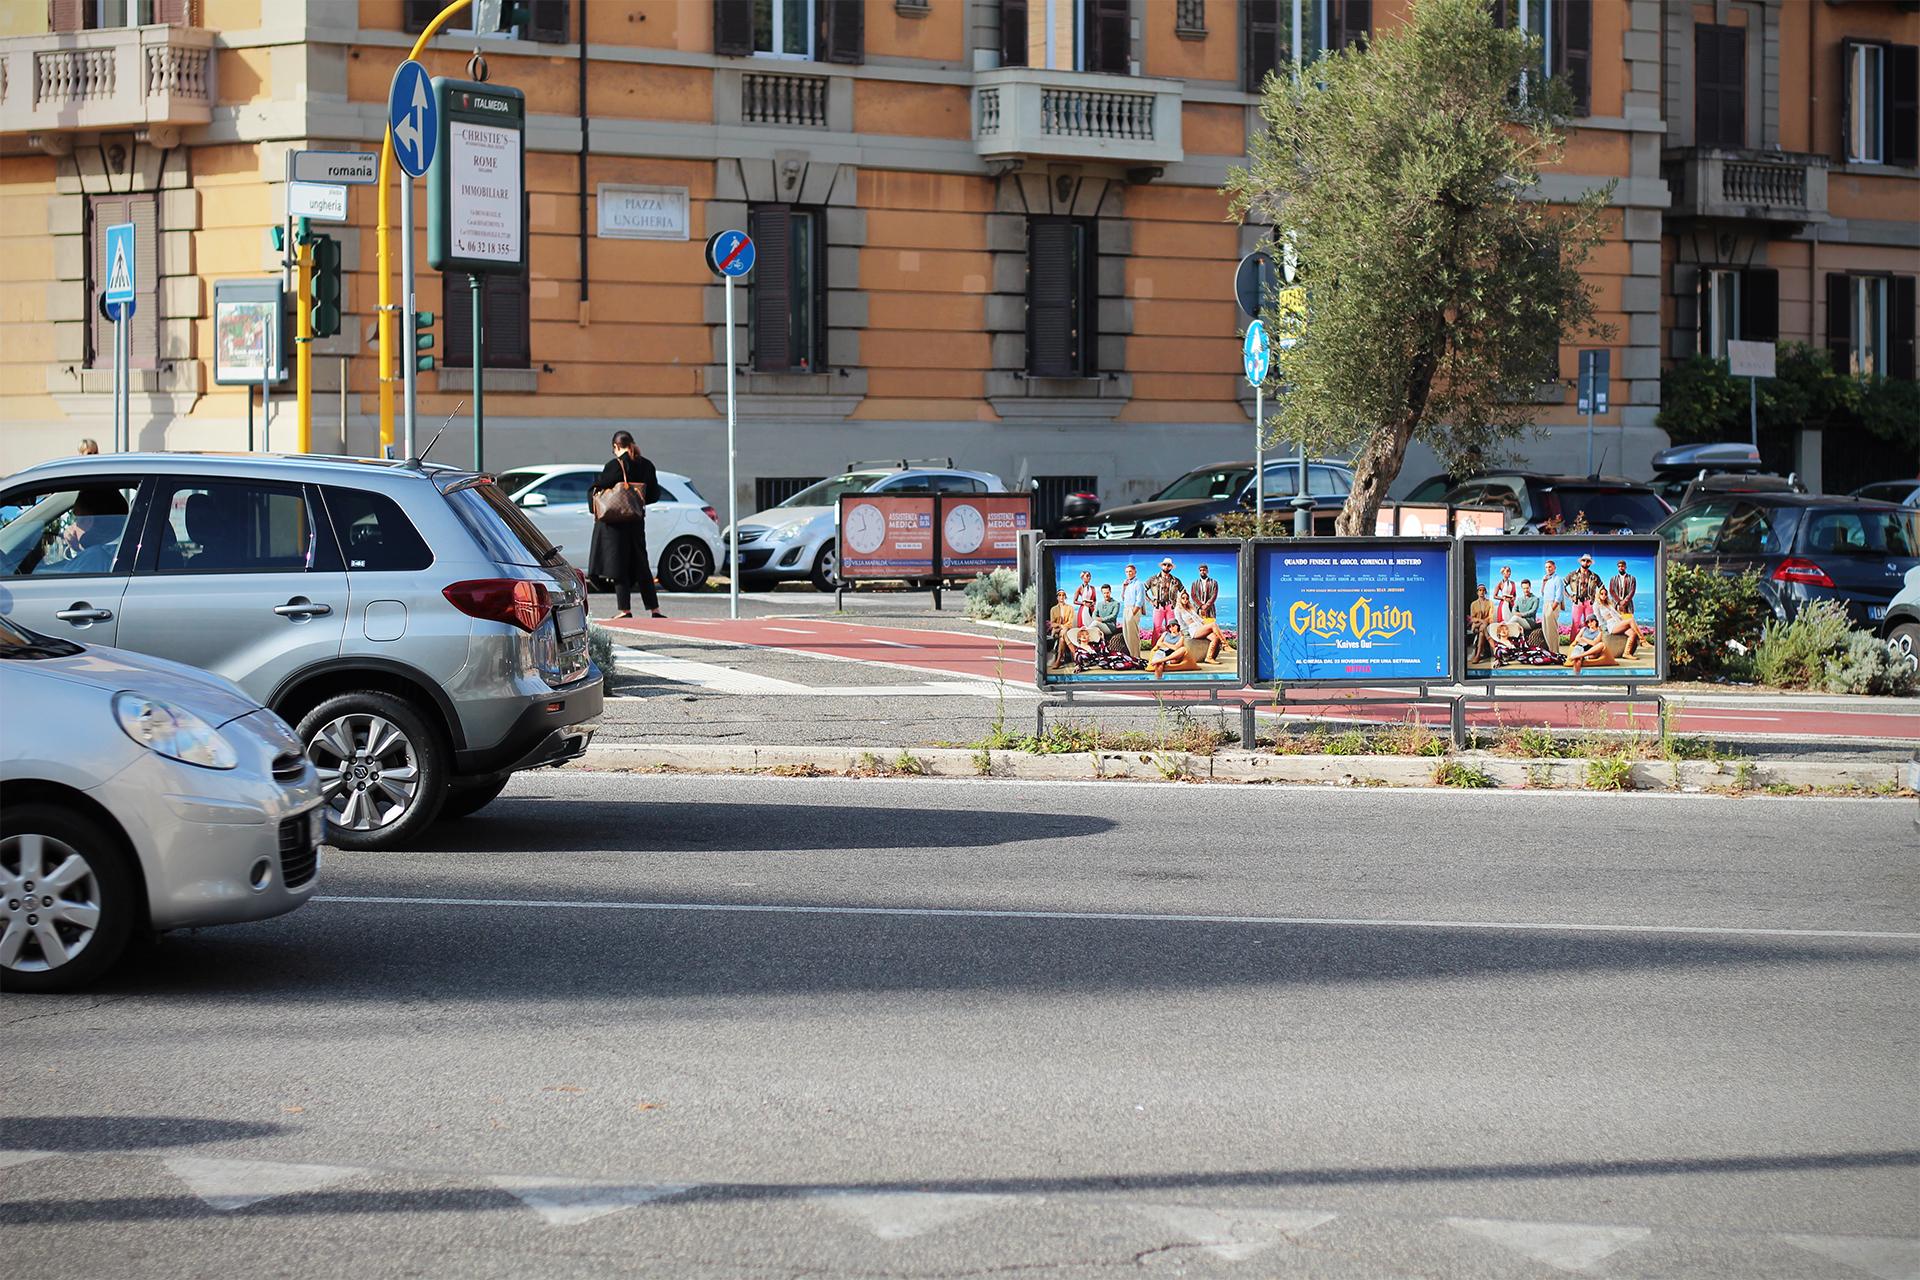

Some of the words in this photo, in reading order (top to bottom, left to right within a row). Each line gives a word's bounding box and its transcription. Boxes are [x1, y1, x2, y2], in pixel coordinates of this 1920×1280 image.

[474, 98, 509, 112] ITALMEDIA
[462, 129, 509, 145] CHRISTIE'S
[473, 155, 498, 168] ROME
[328, 165, 372, 176] romania
[461, 184, 509, 199] IMMOBILIARE
[309, 199, 342, 212] ungheria
[625, 199, 662, 210] PIAZZA
[613, 215, 673, 228] UNGHERIA
[467, 241, 476, 252] 06
[477, 241, 486, 253] 32
[488, 242, 496, 254] 18
[497, 243, 510, 255] 355
[988, 520, 1015, 528] MEDICA
[1284, 558, 1308, 566] QUANDO
[1340, 558, 1359, 566] GIOCO,
[1289, 600, 1348, 639] Glass
[1350, 596, 1416, 640] Onion
[1336, 639, 1360, 648] Knives
[1360, 640, 1372, 648] Out
